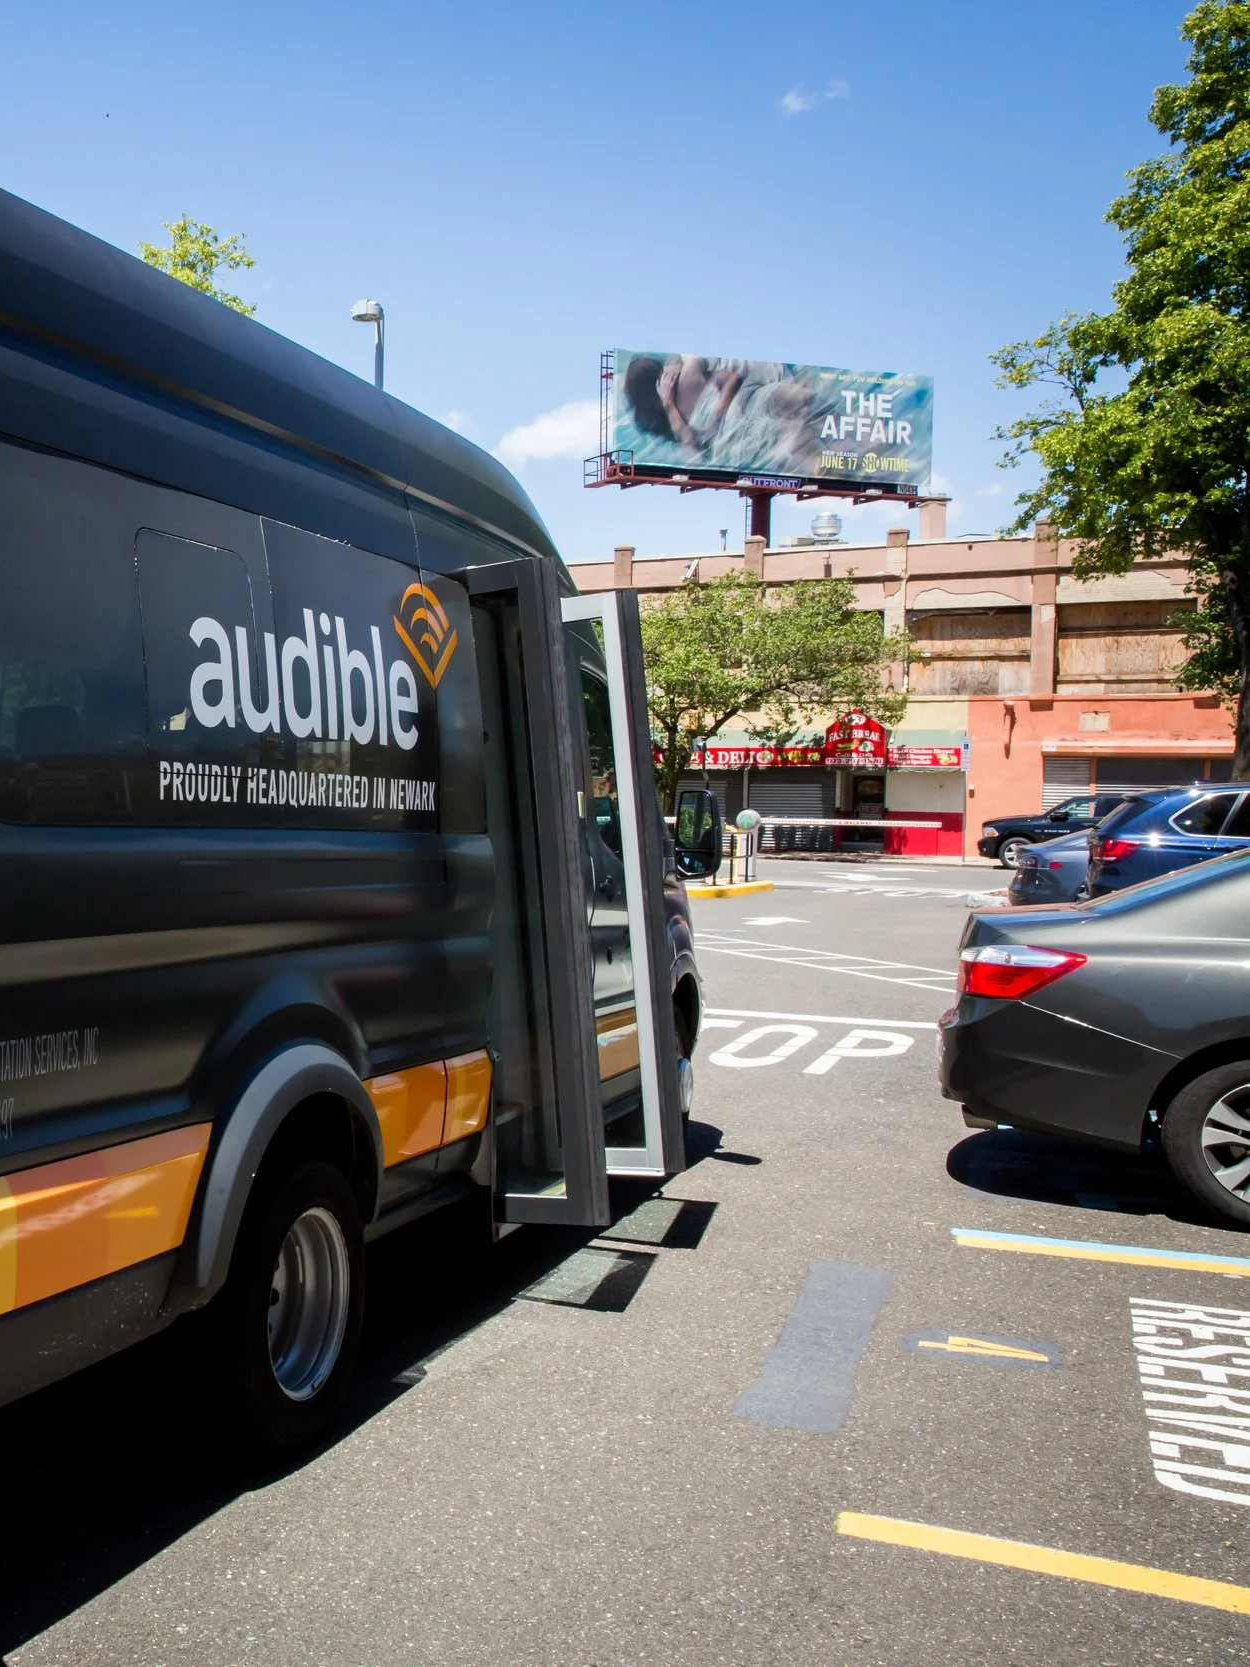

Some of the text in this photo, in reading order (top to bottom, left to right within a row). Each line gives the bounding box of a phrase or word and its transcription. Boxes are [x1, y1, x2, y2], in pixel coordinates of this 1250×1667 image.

[840, 389, 893, 418] THE
[820, 415, 912, 445] AFFAIR
[820, 452, 910, 474] JUNE 17 SHOWTIME
[837, 450, 858, 458] SEASON
[188, 607, 419, 750] audible
[829, 730, 850, 742] FAST
[705, 751, 715, 764] &
[159, 760, 436, 811] PROUDLY HEADQUARTERED IN NEWARK
[34, 1030, 81, 1076] SERVICES,
[84, 1026, 99, 1066] INC
